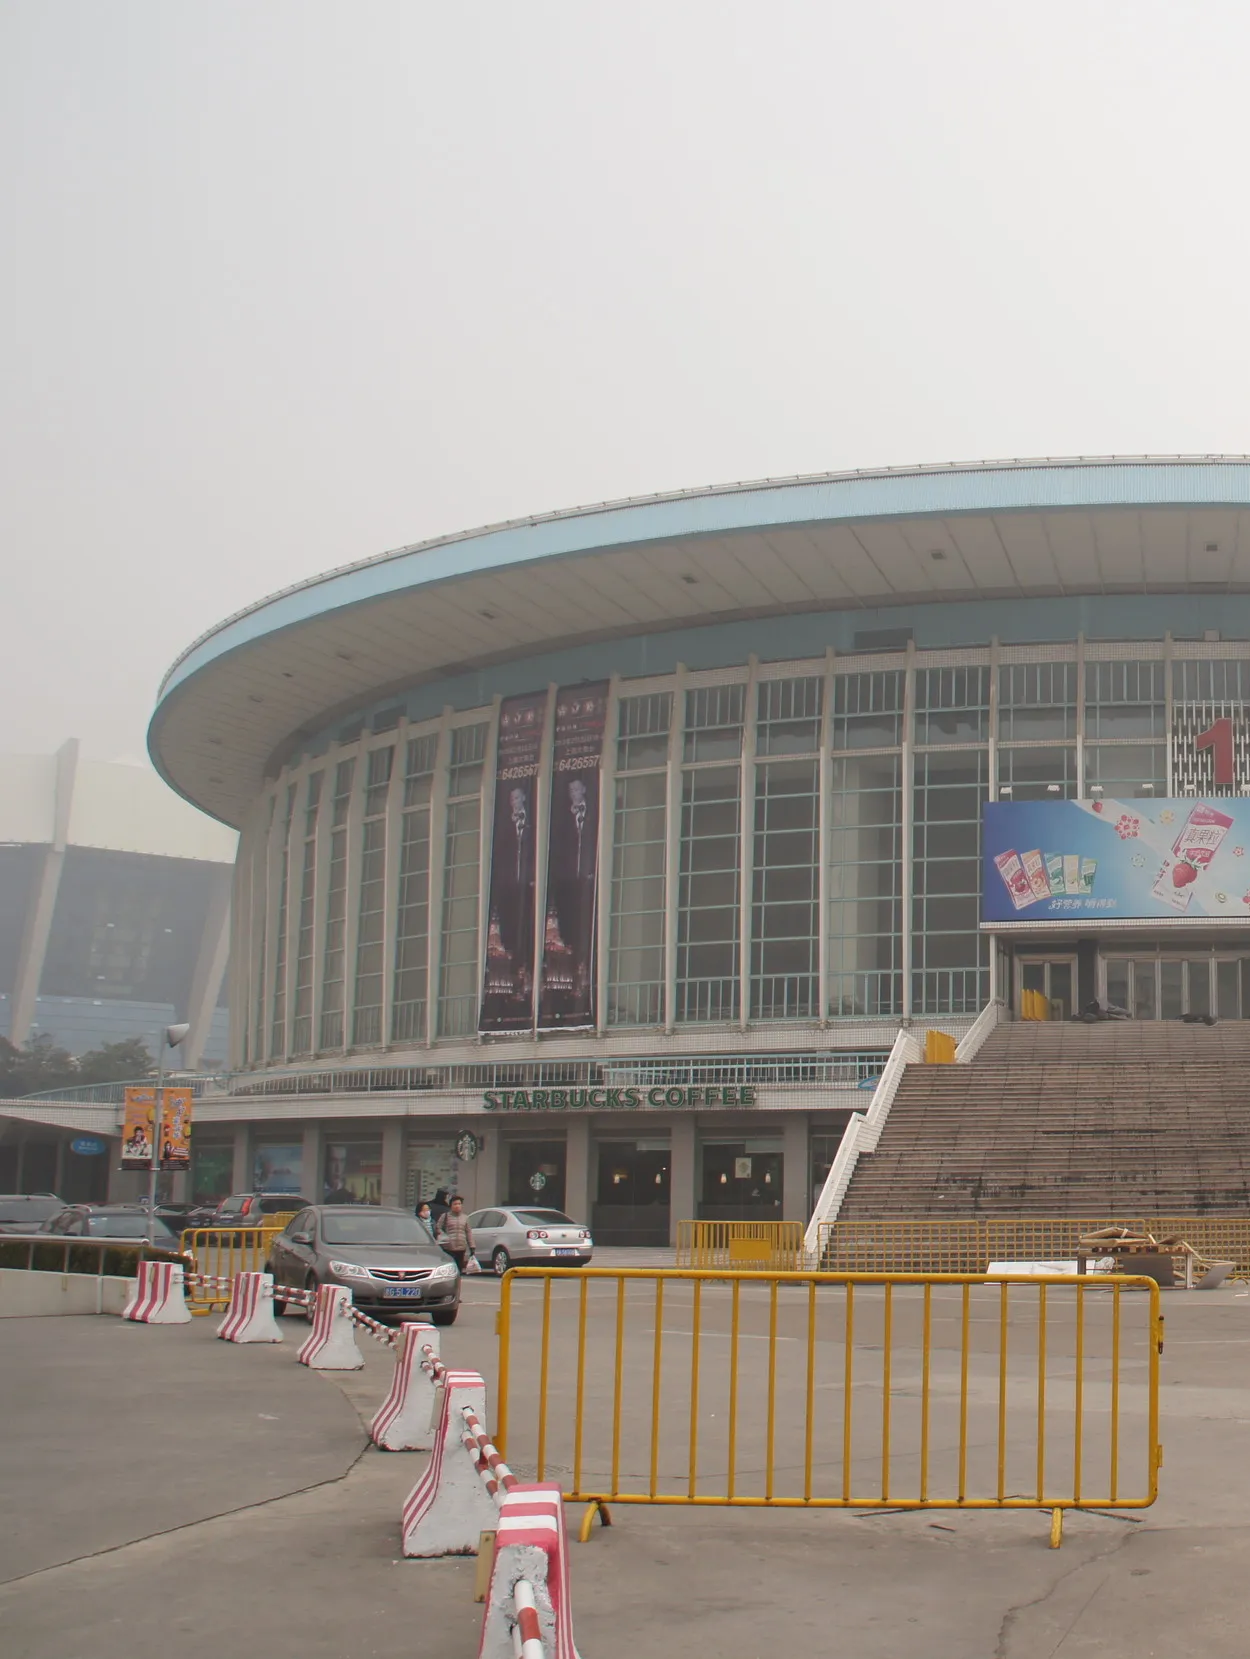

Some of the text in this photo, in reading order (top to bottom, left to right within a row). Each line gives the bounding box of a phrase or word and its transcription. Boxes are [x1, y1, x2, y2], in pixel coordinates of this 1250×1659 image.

[1196, 718, 1233, 784] 1
[1184, 827, 1222, 845] 真果粒
[482, 1085, 758, 1111] STARBUCKS COFFEE
